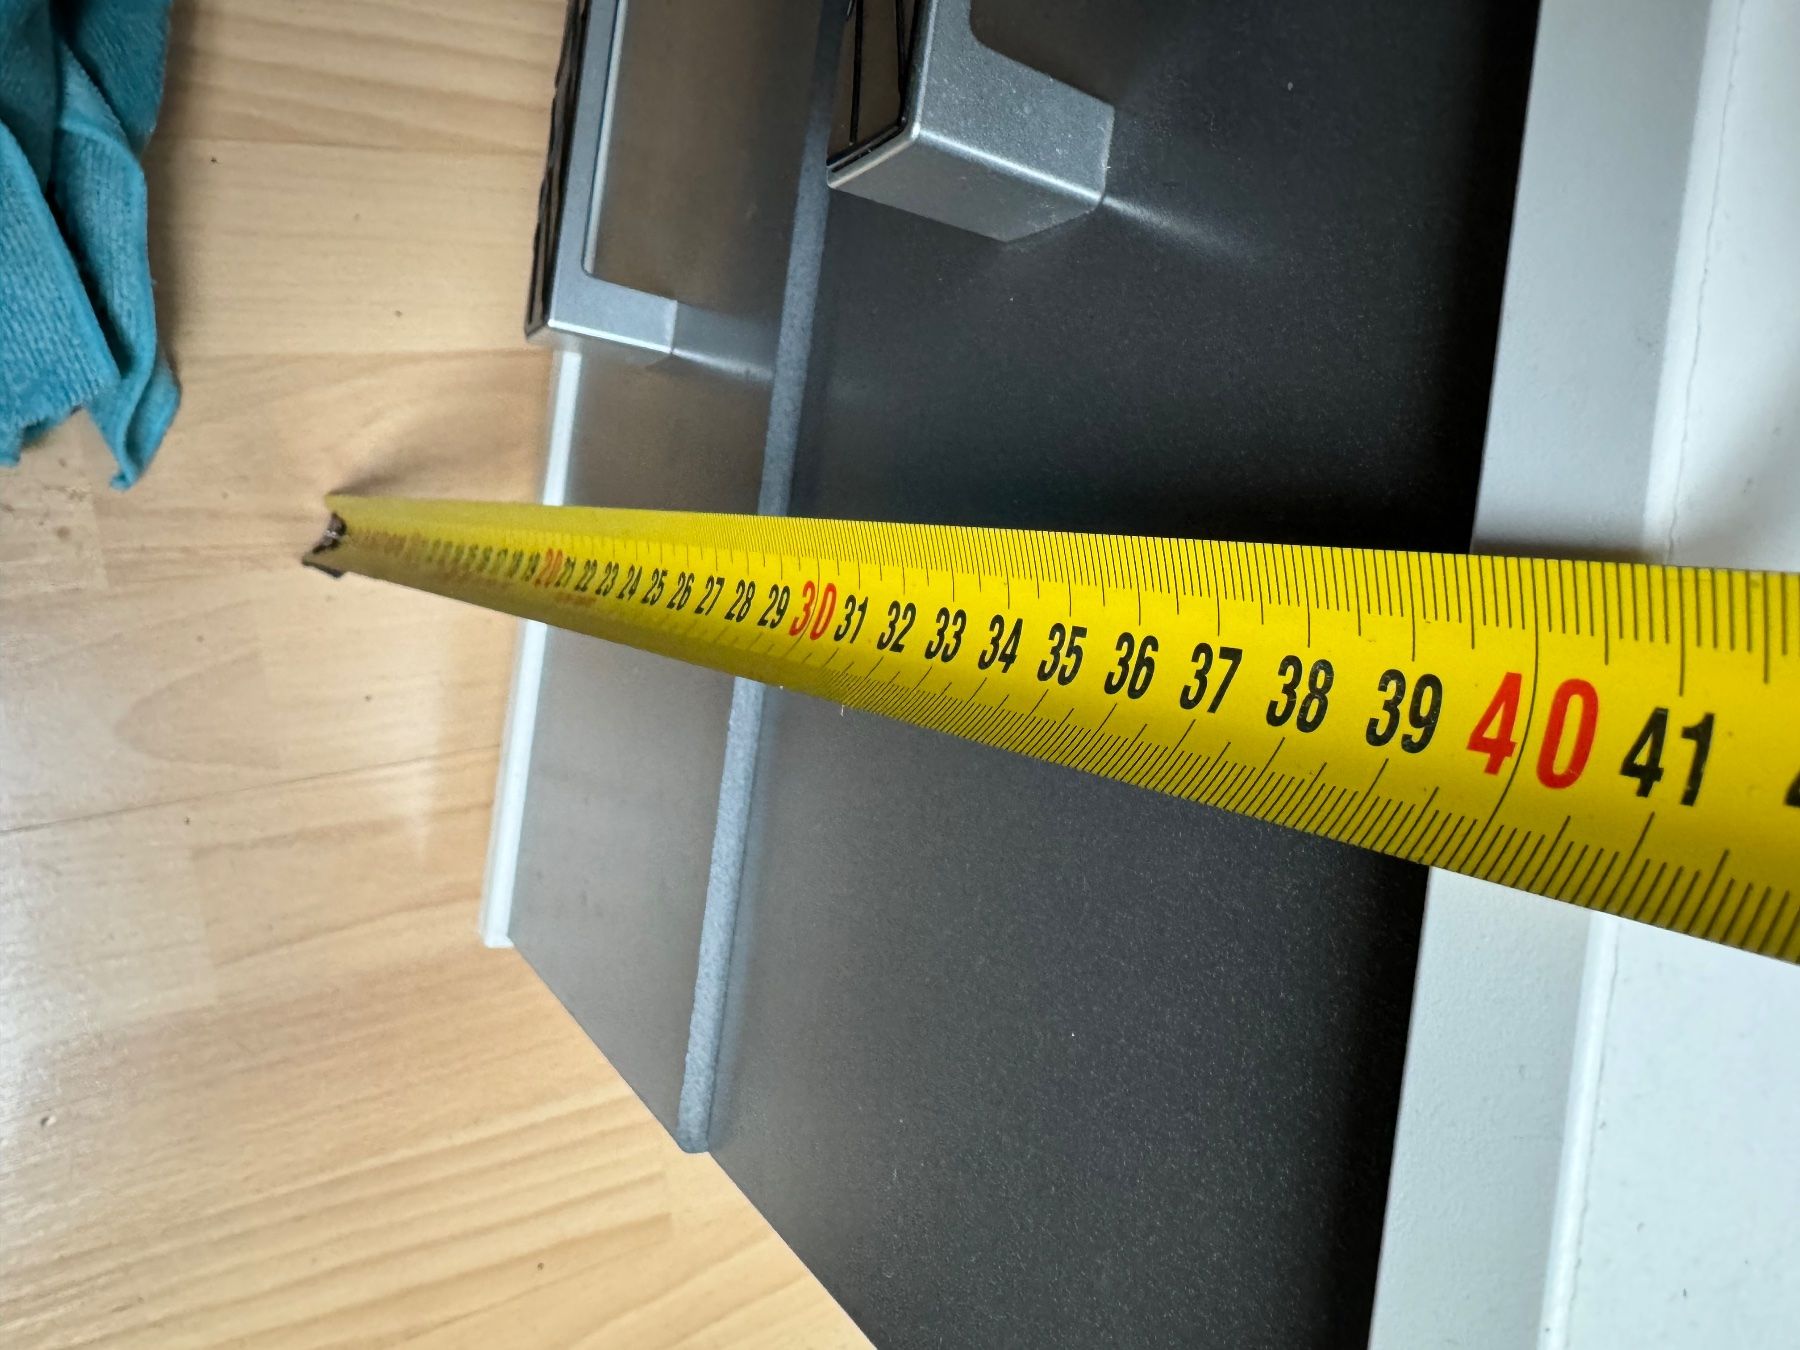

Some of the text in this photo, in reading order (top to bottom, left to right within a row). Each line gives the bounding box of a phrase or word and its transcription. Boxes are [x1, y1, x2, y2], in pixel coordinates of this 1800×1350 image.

[534, 547, 564, 588] 20
[554, 556, 577, 588] 21
[574, 559, 598, 592] 22
[595, 561, 620, 597] 23
[616, 564, 643, 601] 24
[640, 568, 668, 606] 25
[666, 571, 695, 611] 26
[694, 575, 726, 616] 27
[724, 579, 756, 623] 28
[757, 583, 791, 629] 29
[788, 580, 837, 641] 30
[833, 594, 869, 644] 31
[876, 600, 917, 653] 32
[924, 607, 967, 663] 33
[977, 614, 1023, 674] 34
[1036, 622, 1088, 686] 35
[1103, 631, 1159, 700] 36
[1180, 642, 1242, 714] 37
[1266, 655, 1335, 733] 38
[1365, 669, 1443, 753] 39
[1468, 671, 1600, 790] 40
[1620, 707, 1715, 806] 41
